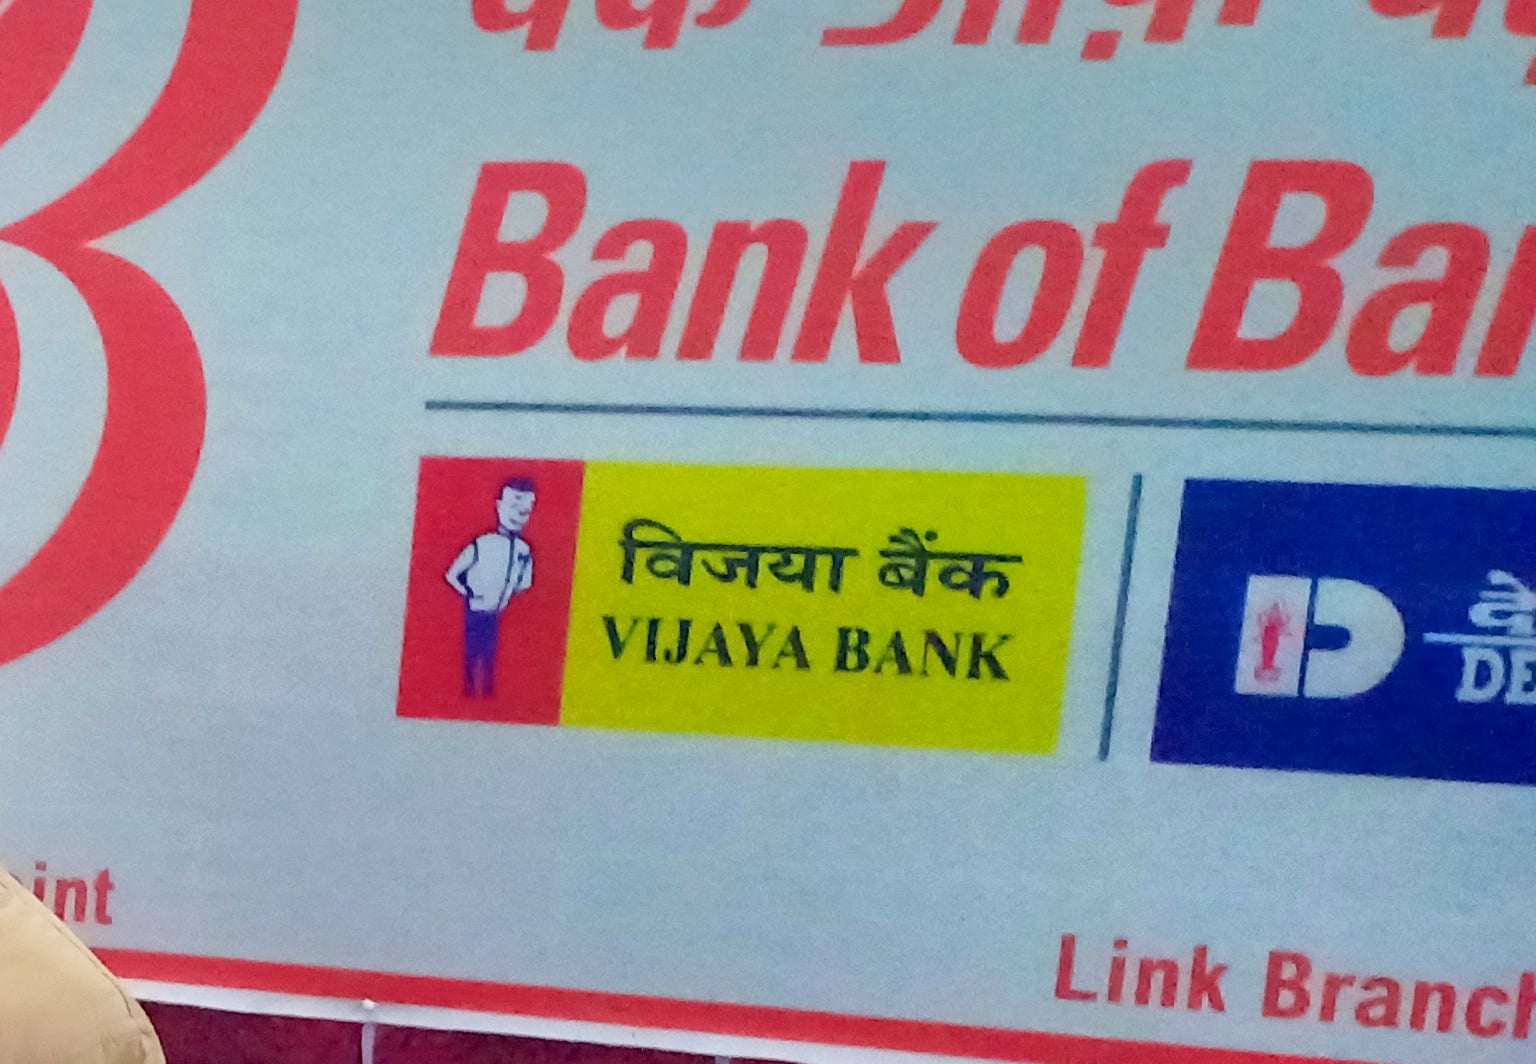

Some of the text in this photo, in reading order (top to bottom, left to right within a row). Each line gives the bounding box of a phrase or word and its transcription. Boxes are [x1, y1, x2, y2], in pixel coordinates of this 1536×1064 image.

[427, 159, 939, 366] Bank
[955, 159, 1193, 371] of
[618, 518, 1023, 600] विजया बैंक
[602, 614, 1014, 682] VIJAYA BANK
[32, 859, 116, 925] int
[1054, 931, 1228, 1012] Link
